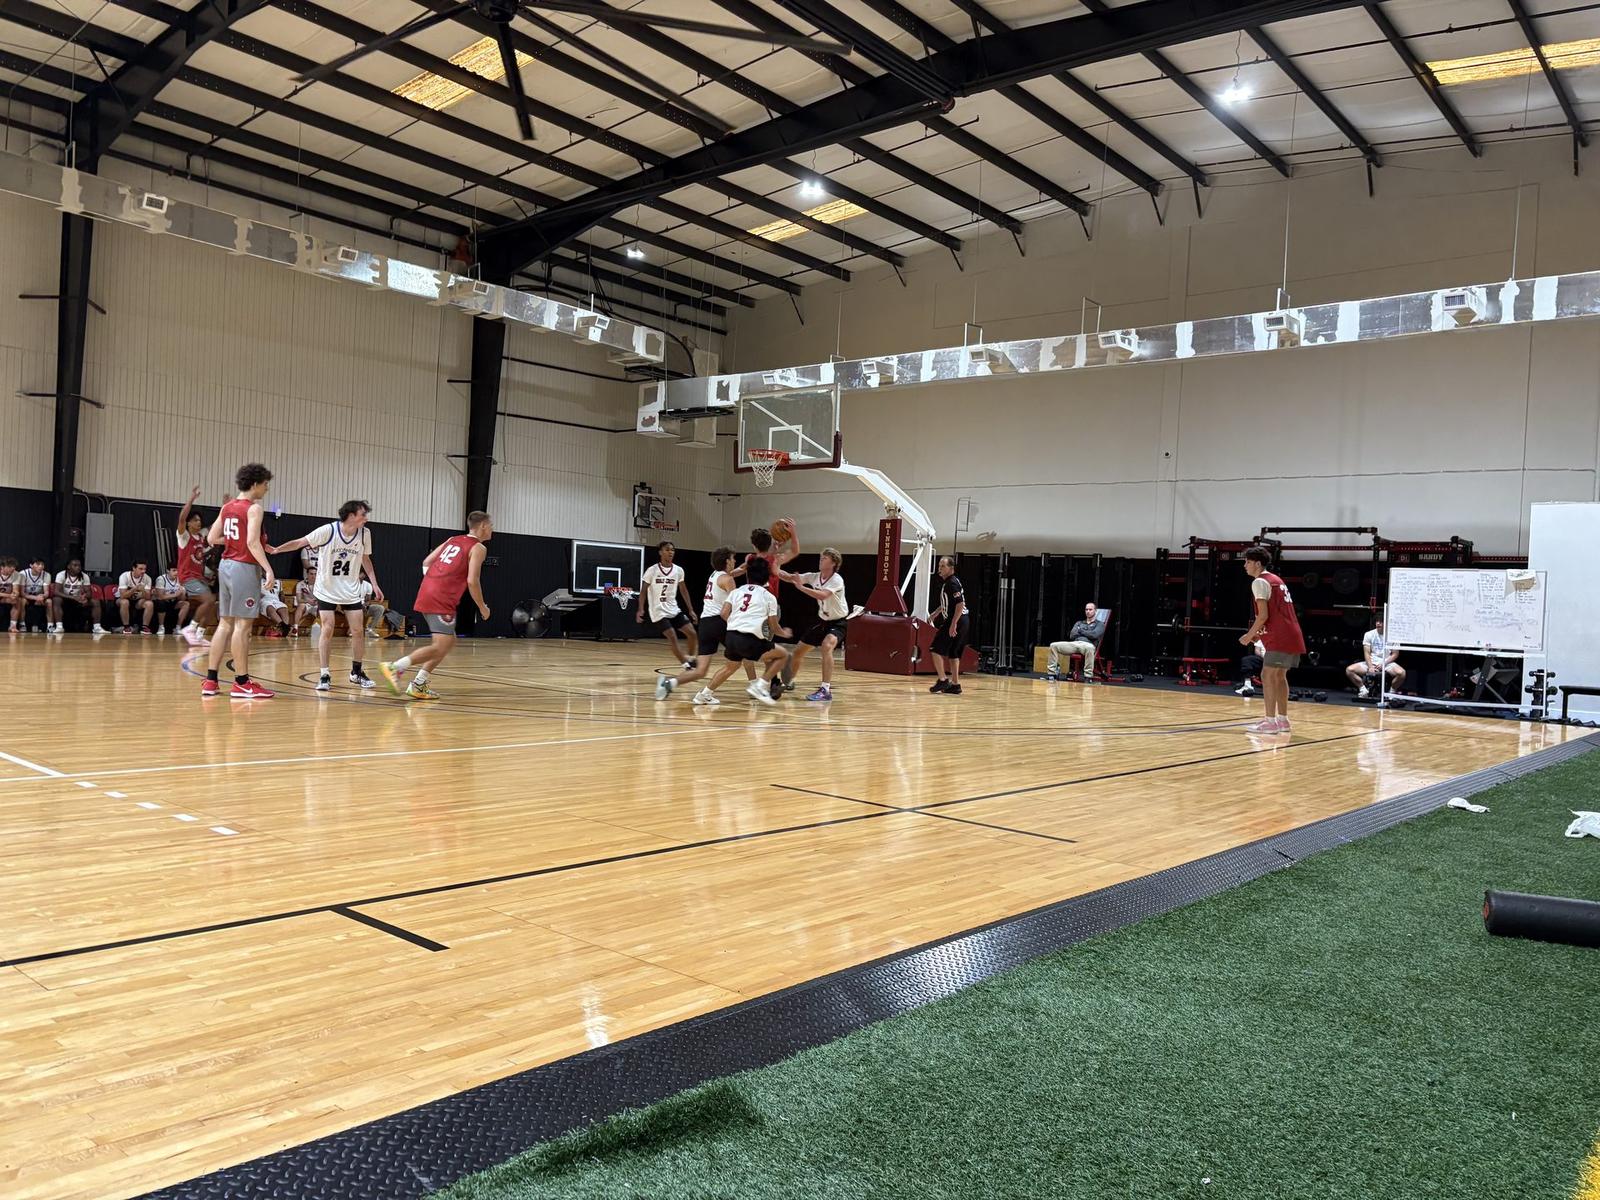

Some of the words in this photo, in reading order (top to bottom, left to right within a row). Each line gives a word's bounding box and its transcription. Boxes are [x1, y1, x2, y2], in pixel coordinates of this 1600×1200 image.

[223, 517, 240, 541] 45
[439, 544, 461, 564] 42
[882, 522, 892, 581] MINNESOTA
[332, 560, 350, 576] 24
[661, 585, 668, 596] 2
[739, 593, 752, 612] 3
